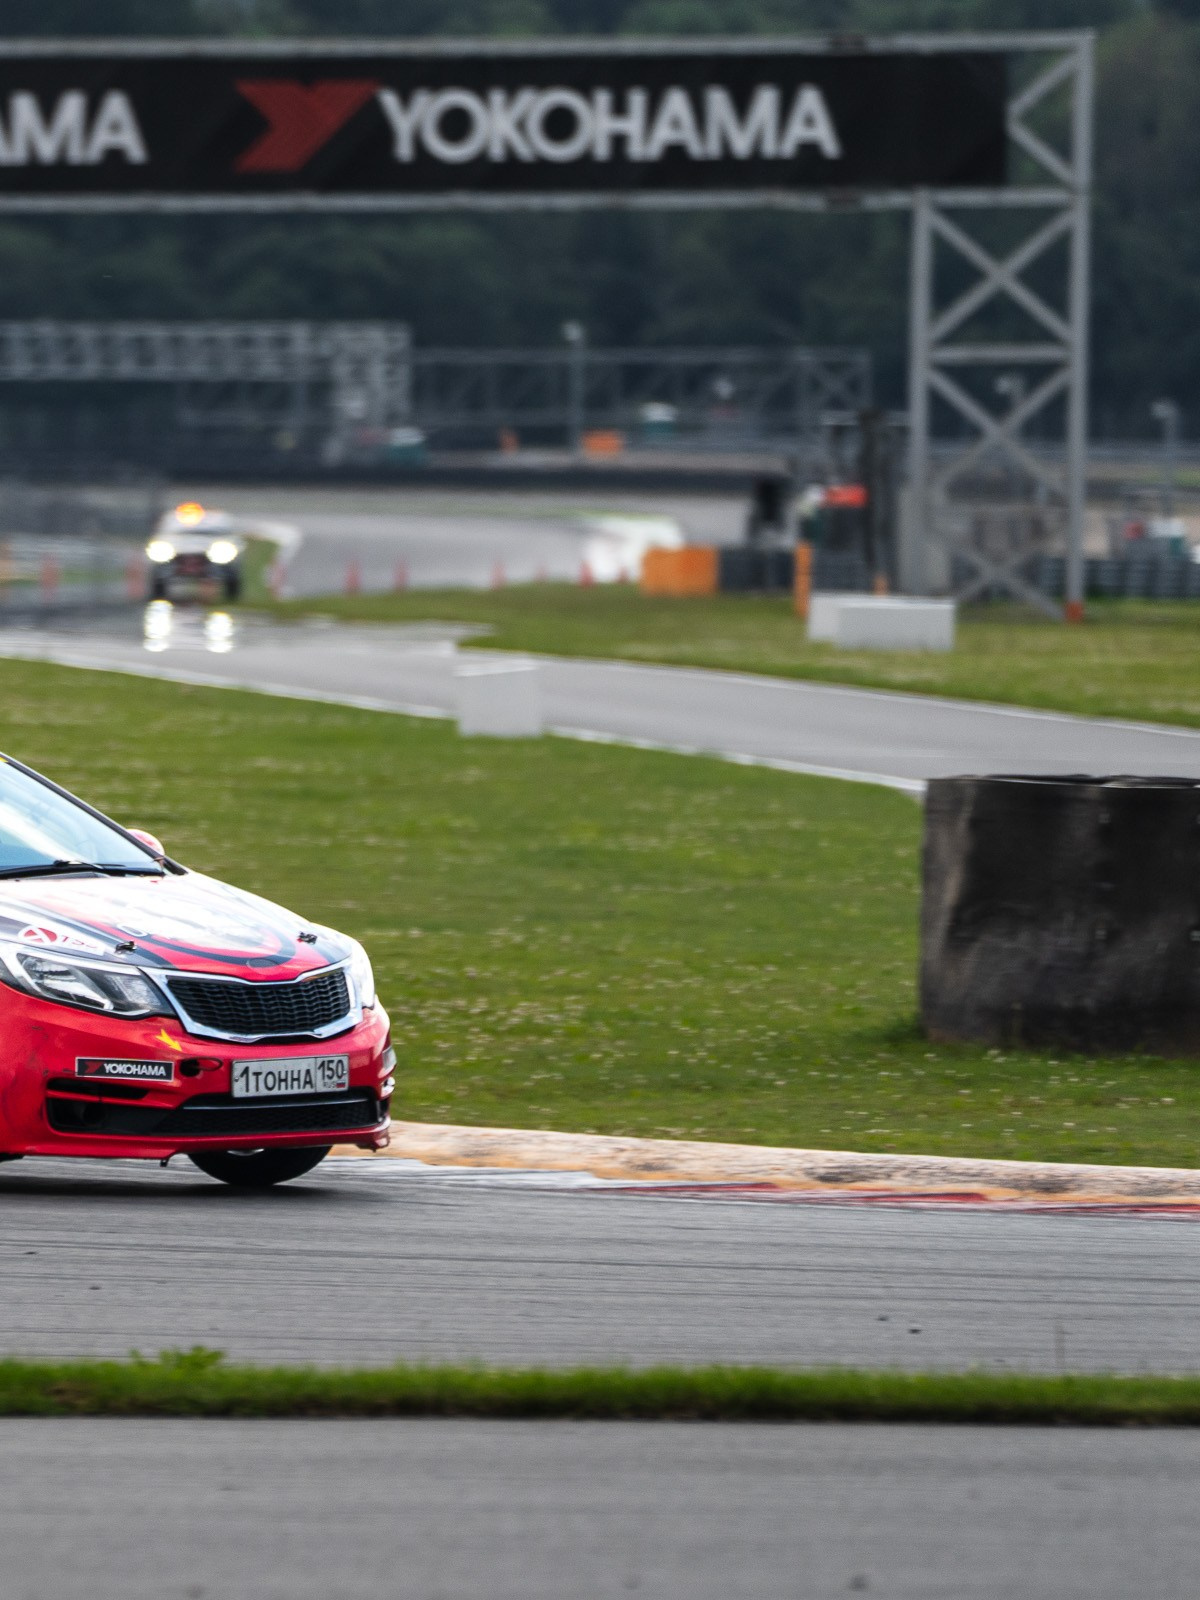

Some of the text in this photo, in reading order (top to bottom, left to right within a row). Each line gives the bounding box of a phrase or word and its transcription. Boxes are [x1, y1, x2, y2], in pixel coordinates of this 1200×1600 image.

[379, 85, 840, 161] YOKOHAMA
[103, 1062, 167, 1077] YOKOHAMA
[318, 1059, 345, 1081] 150
